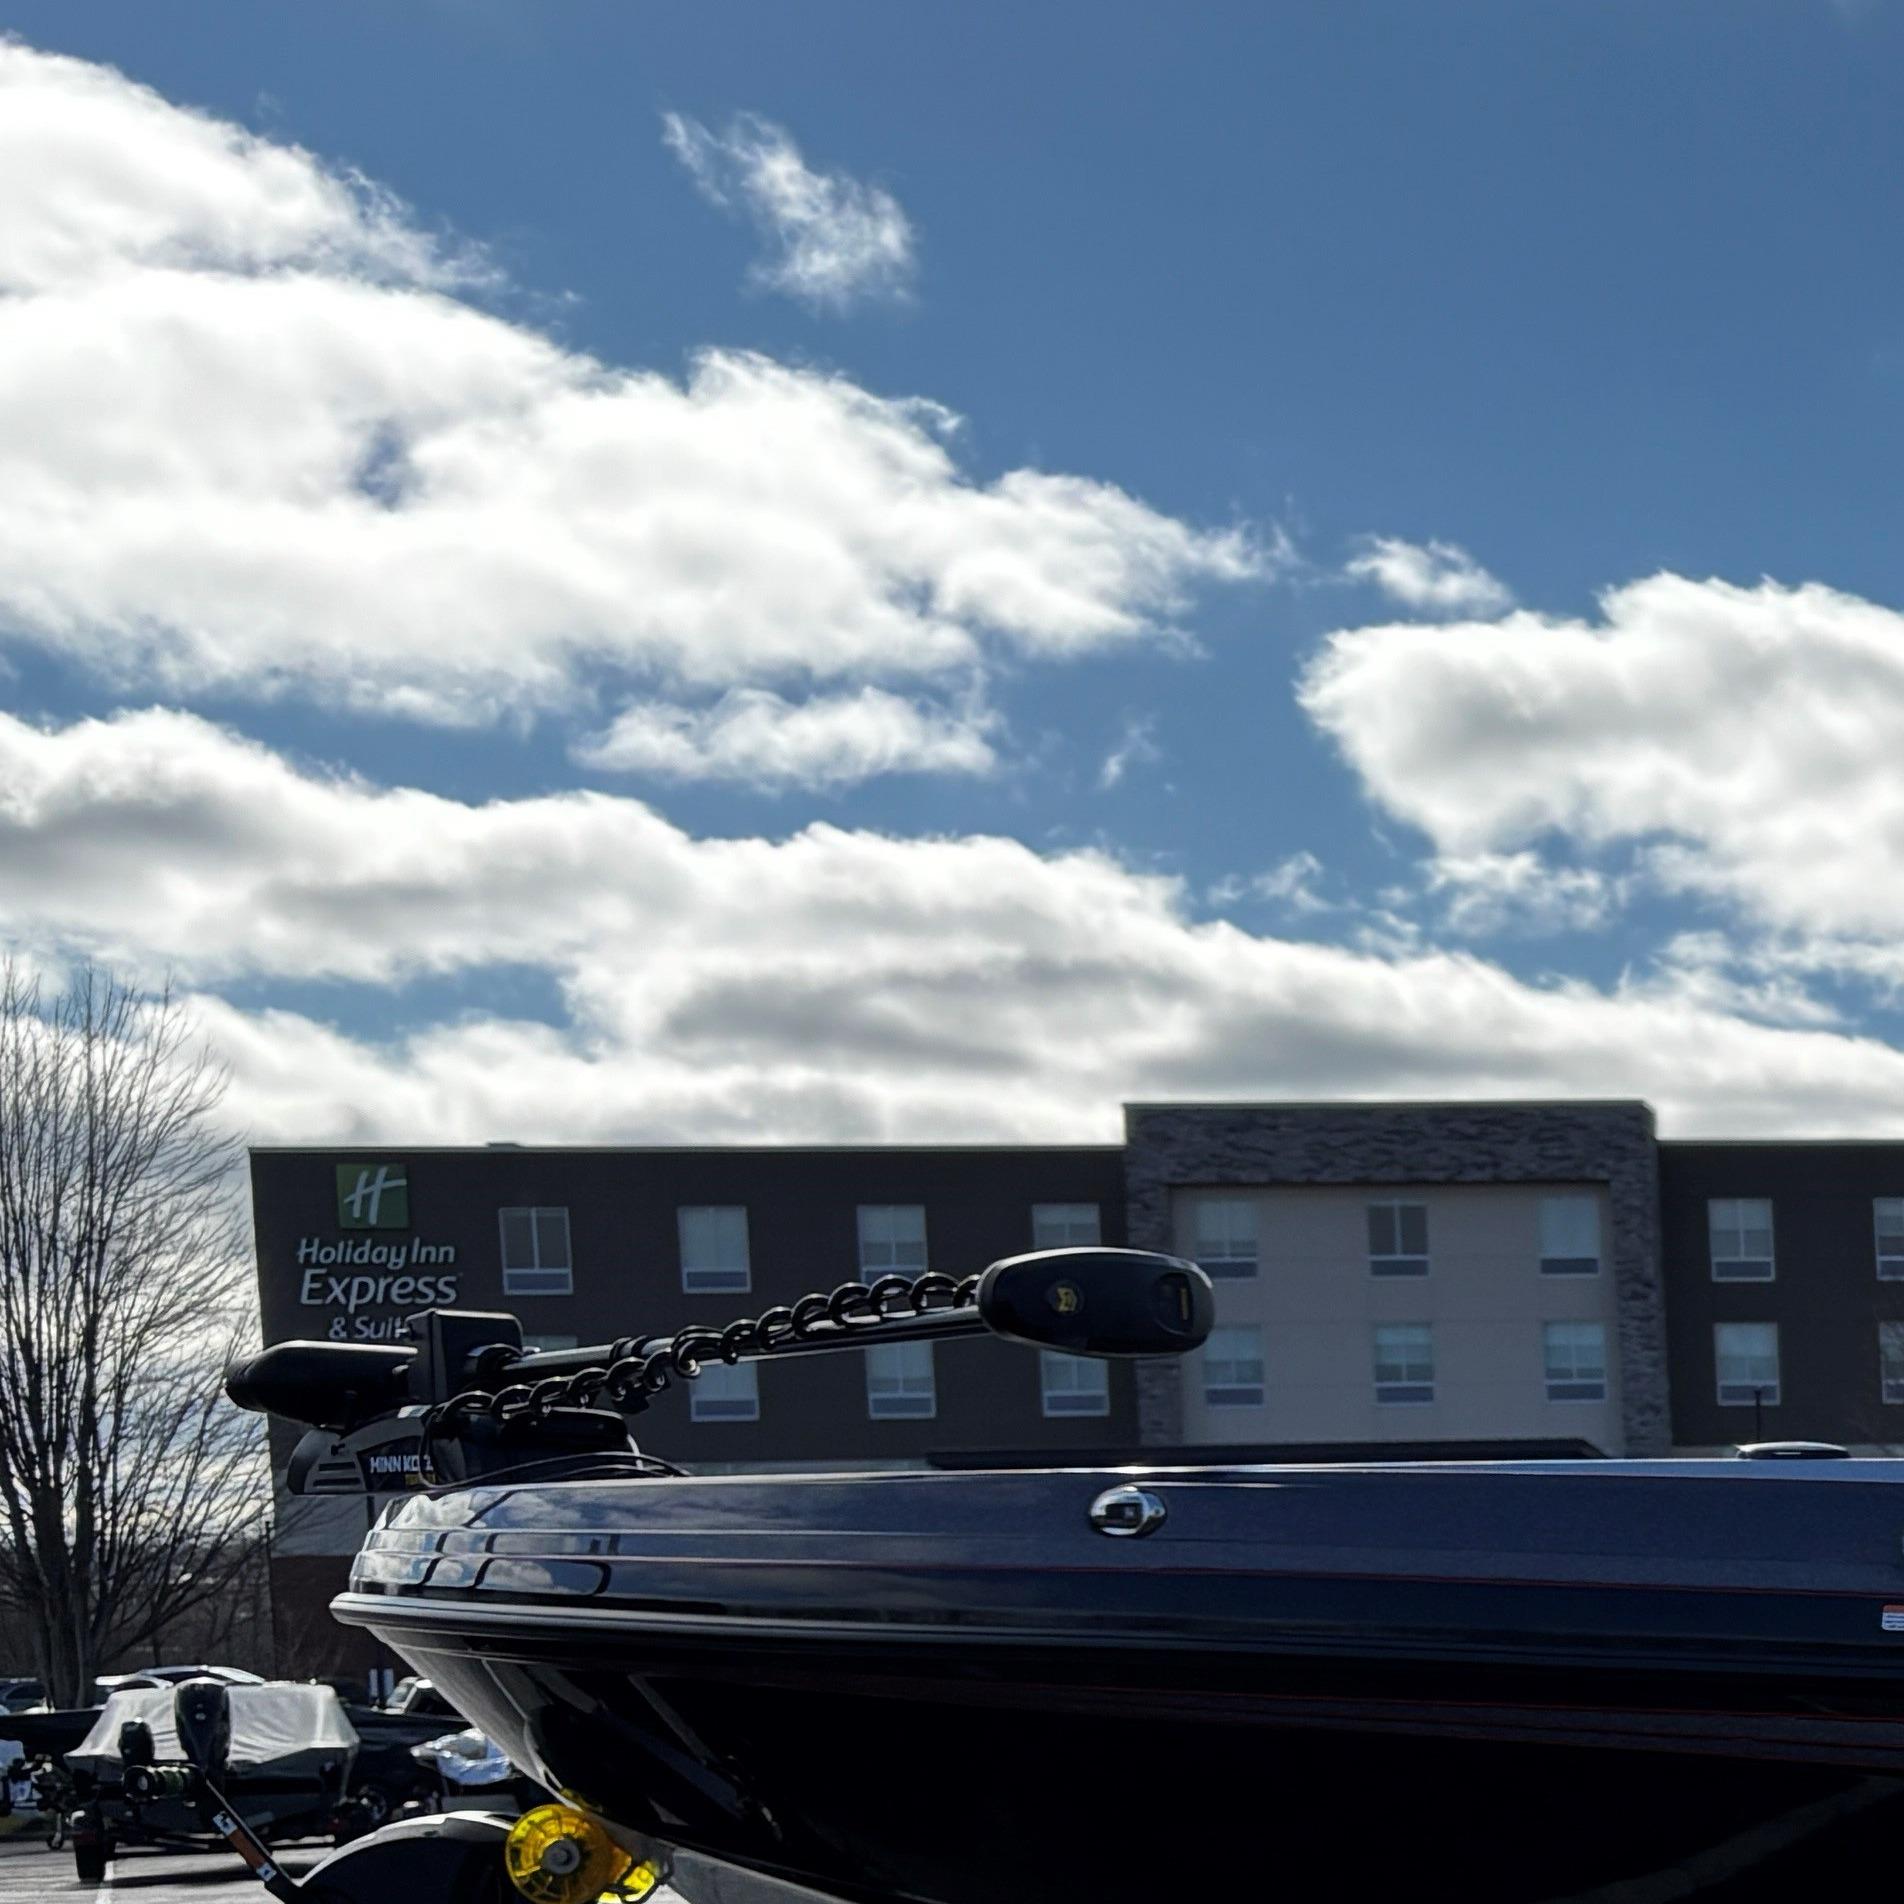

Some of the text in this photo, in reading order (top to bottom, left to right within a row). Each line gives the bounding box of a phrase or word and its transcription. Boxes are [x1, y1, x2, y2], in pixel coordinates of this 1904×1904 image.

[297, 1237, 456, 1271] Holiday Inn
[300, 1268, 457, 1315] Express
[328, 1316, 347, 1340] &
[369, 1455, 401, 1474] MINN
